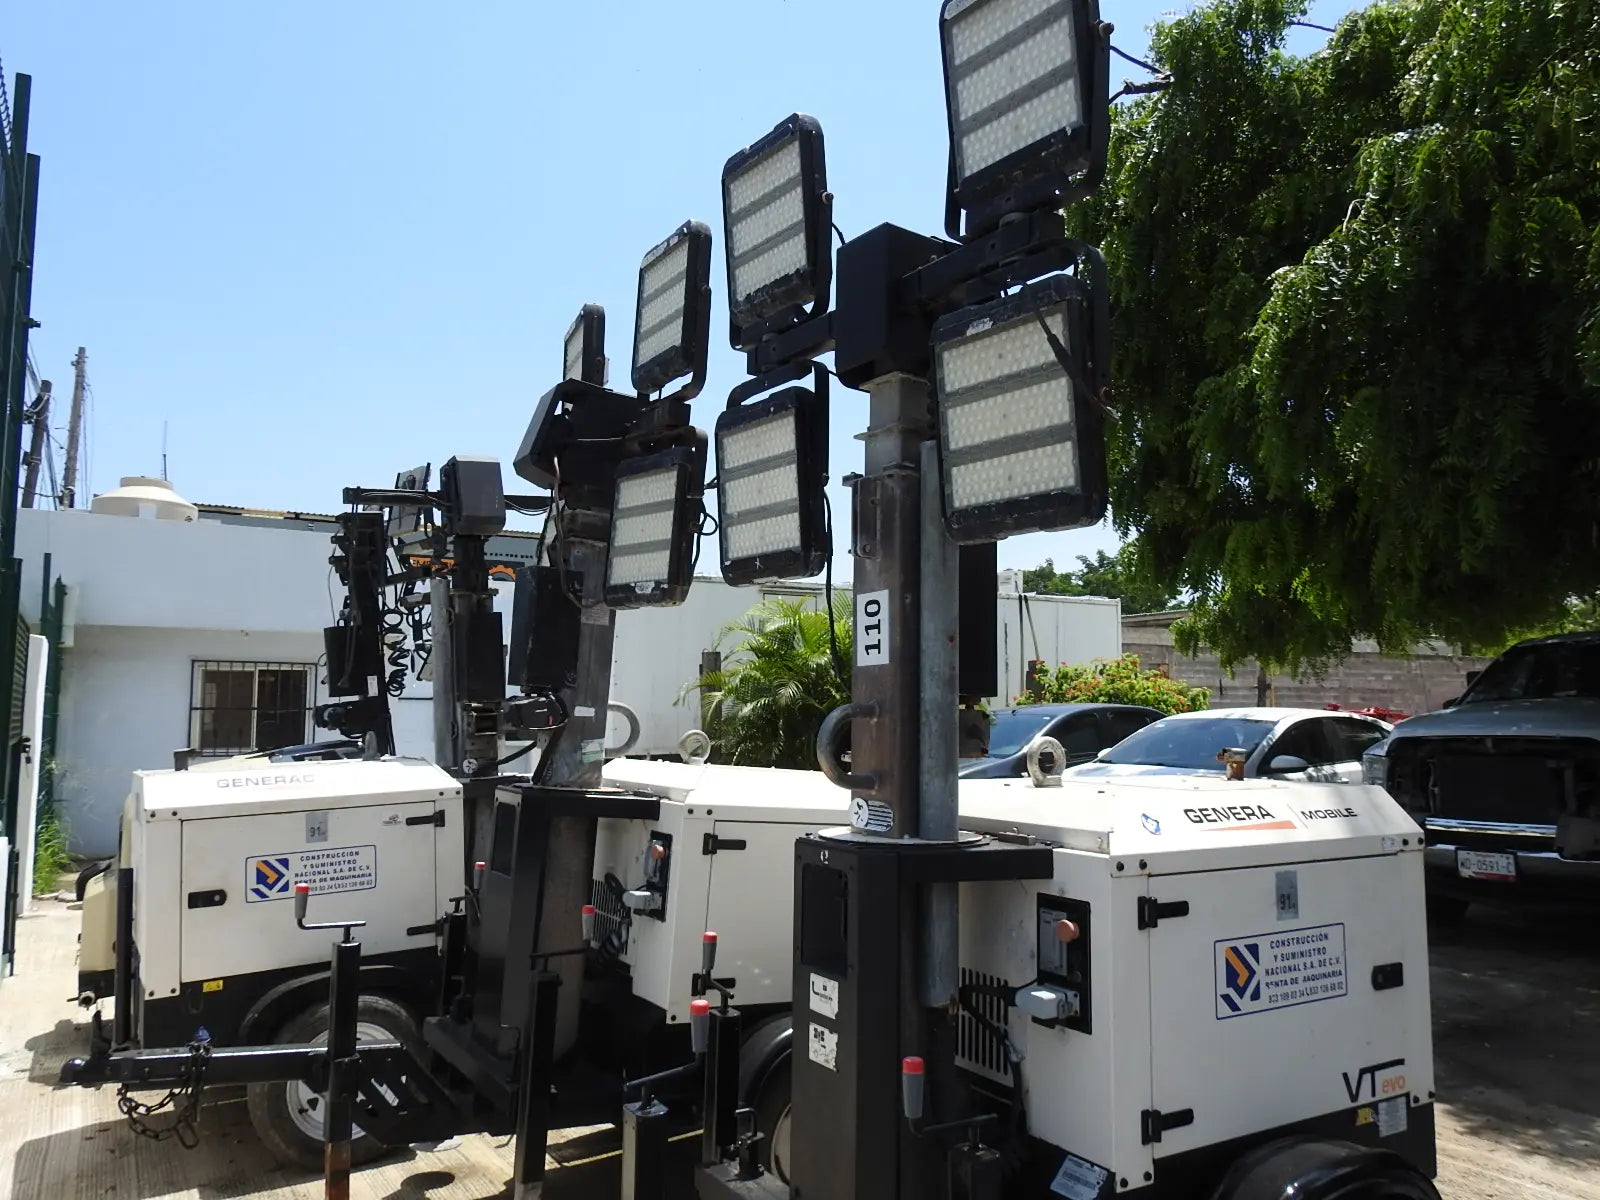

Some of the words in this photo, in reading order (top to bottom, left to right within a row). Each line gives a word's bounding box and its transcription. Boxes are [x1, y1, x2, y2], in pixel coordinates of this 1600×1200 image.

[864, 598, 881, 656] 110
[216, 774, 315, 788] GENERAC
[1300, 807, 1358, 820] MOBILE
[300, 850, 360, 861] CONSTRUCCION
[310, 858, 357, 869] SUMINISTRO
[294, 869, 330, 878] NACIONAL
[329, 872, 372, 882] MAQUINARIA
[1273, 954, 1278, 963] Y
[1281, 946, 1327, 961] SUMINISTRO
[1265, 962, 1301, 976] NACIONAL
[1303, 961, 1316, 970] S.A.
[1318, 958, 1327, 967] DE
[1329, 957, 1341, 966] C.V.
[1290, 976, 1299, 985] DE
[1342, 1058, 1405, 1103] VT
[1382, 1075, 1406, 1094] evo
